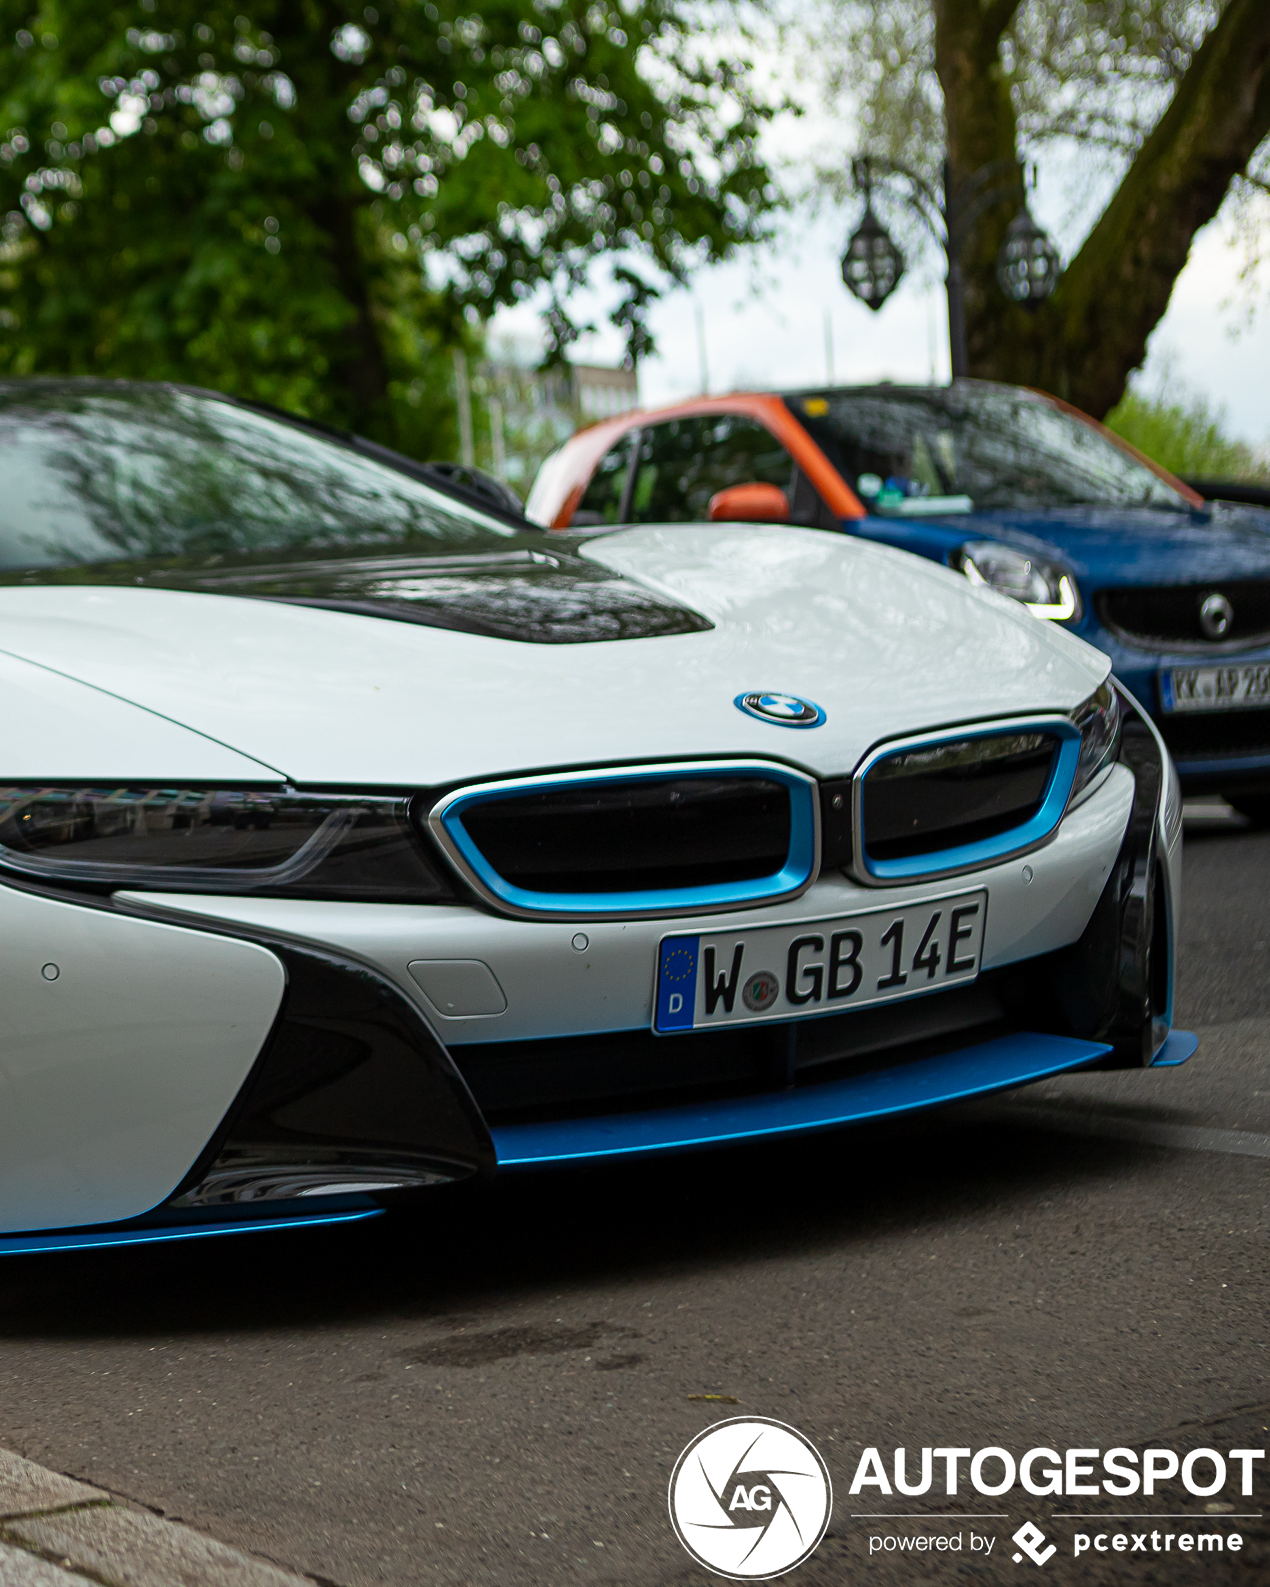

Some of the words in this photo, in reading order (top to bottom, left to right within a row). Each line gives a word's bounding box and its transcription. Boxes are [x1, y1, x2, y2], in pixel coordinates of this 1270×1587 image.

[704, 941, 744, 1014] W
[785, 927, 865, 1005] GB
[877, 902, 980, 991] 14E
[669, 993, 684, 1015] D
